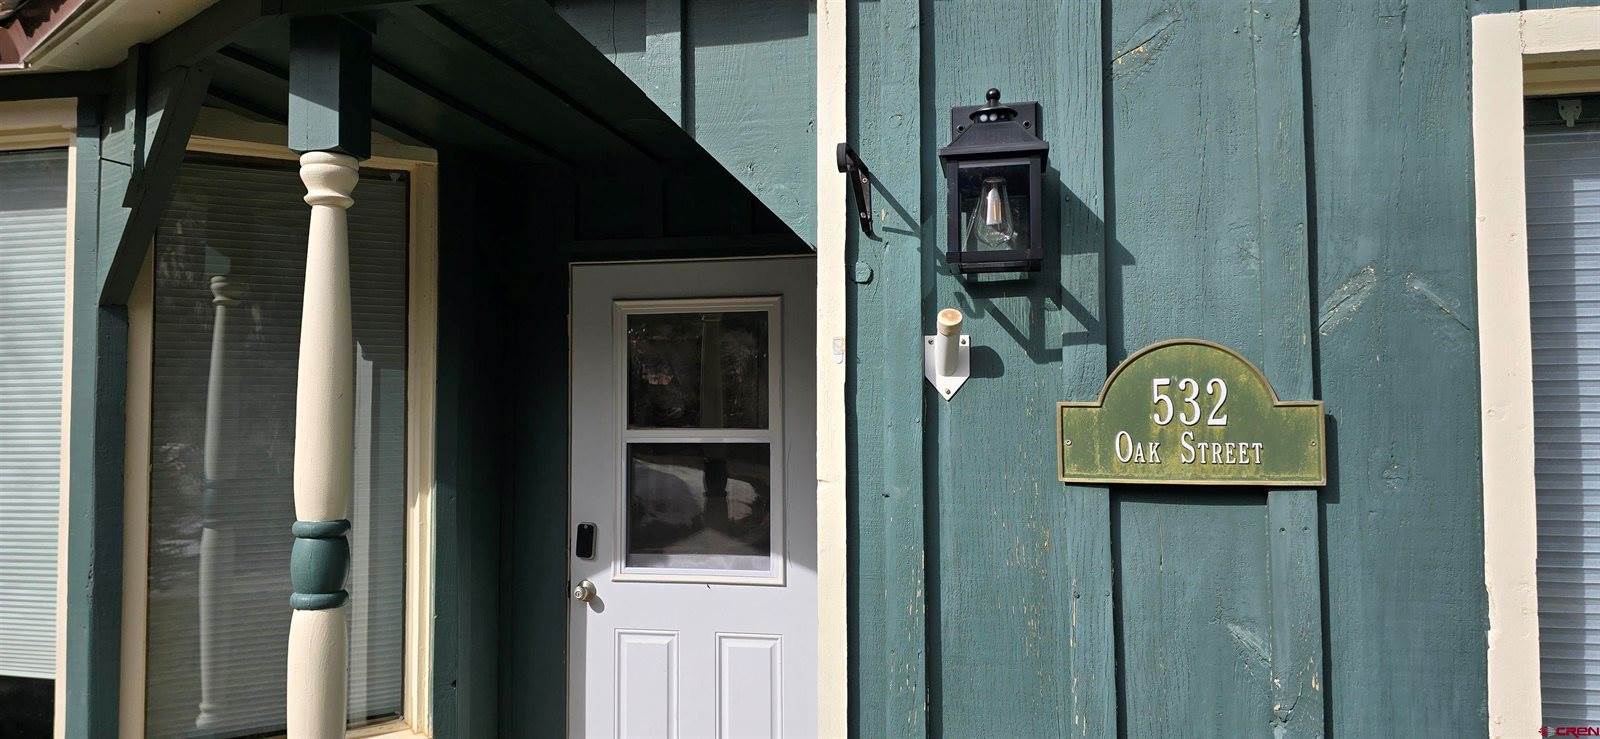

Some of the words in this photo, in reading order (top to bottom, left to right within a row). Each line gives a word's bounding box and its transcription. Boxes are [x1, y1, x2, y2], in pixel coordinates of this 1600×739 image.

[1153, 378, 1228, 426] 532
[1115, 430, 1162, 463] OAK
[1181, 431, 1263, 464] STREET
